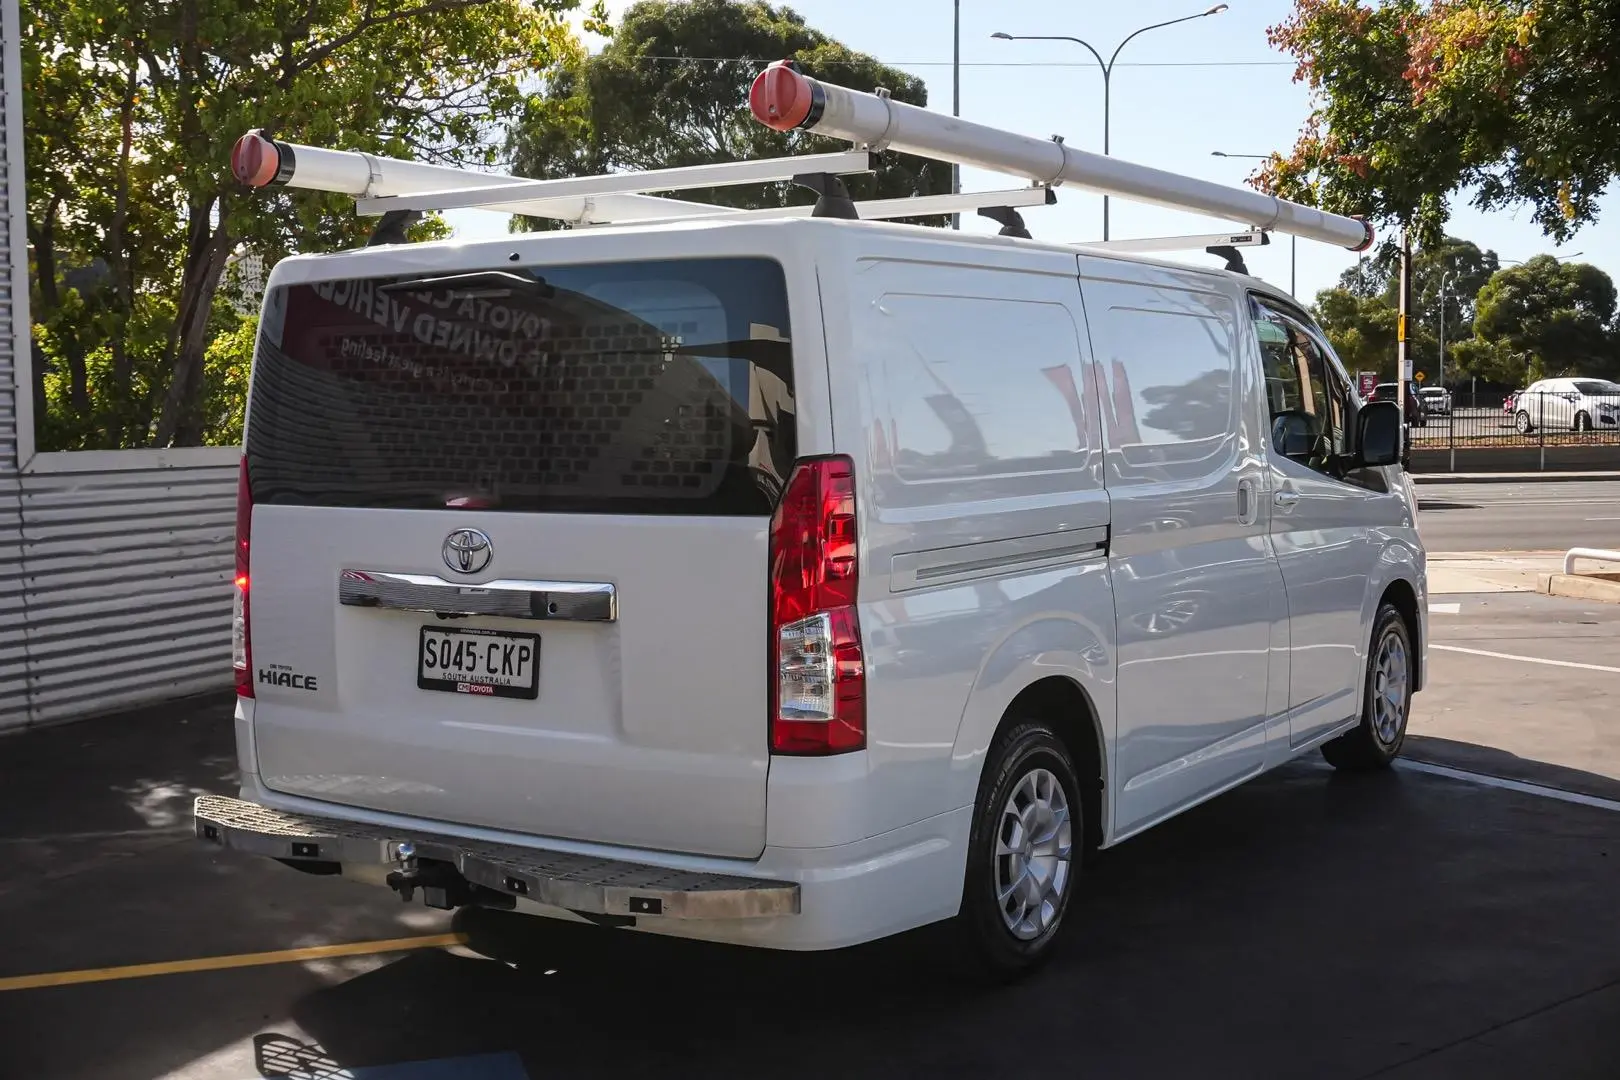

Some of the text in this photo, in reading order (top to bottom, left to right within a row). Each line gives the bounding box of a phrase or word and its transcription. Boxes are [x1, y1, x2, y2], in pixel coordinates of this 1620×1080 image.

[259, 669, 318, 691] HIACE
[442, 672, 511, 686] SOUTH AUSTRALIA
[470, 685, 493, 693] TOYOTA
